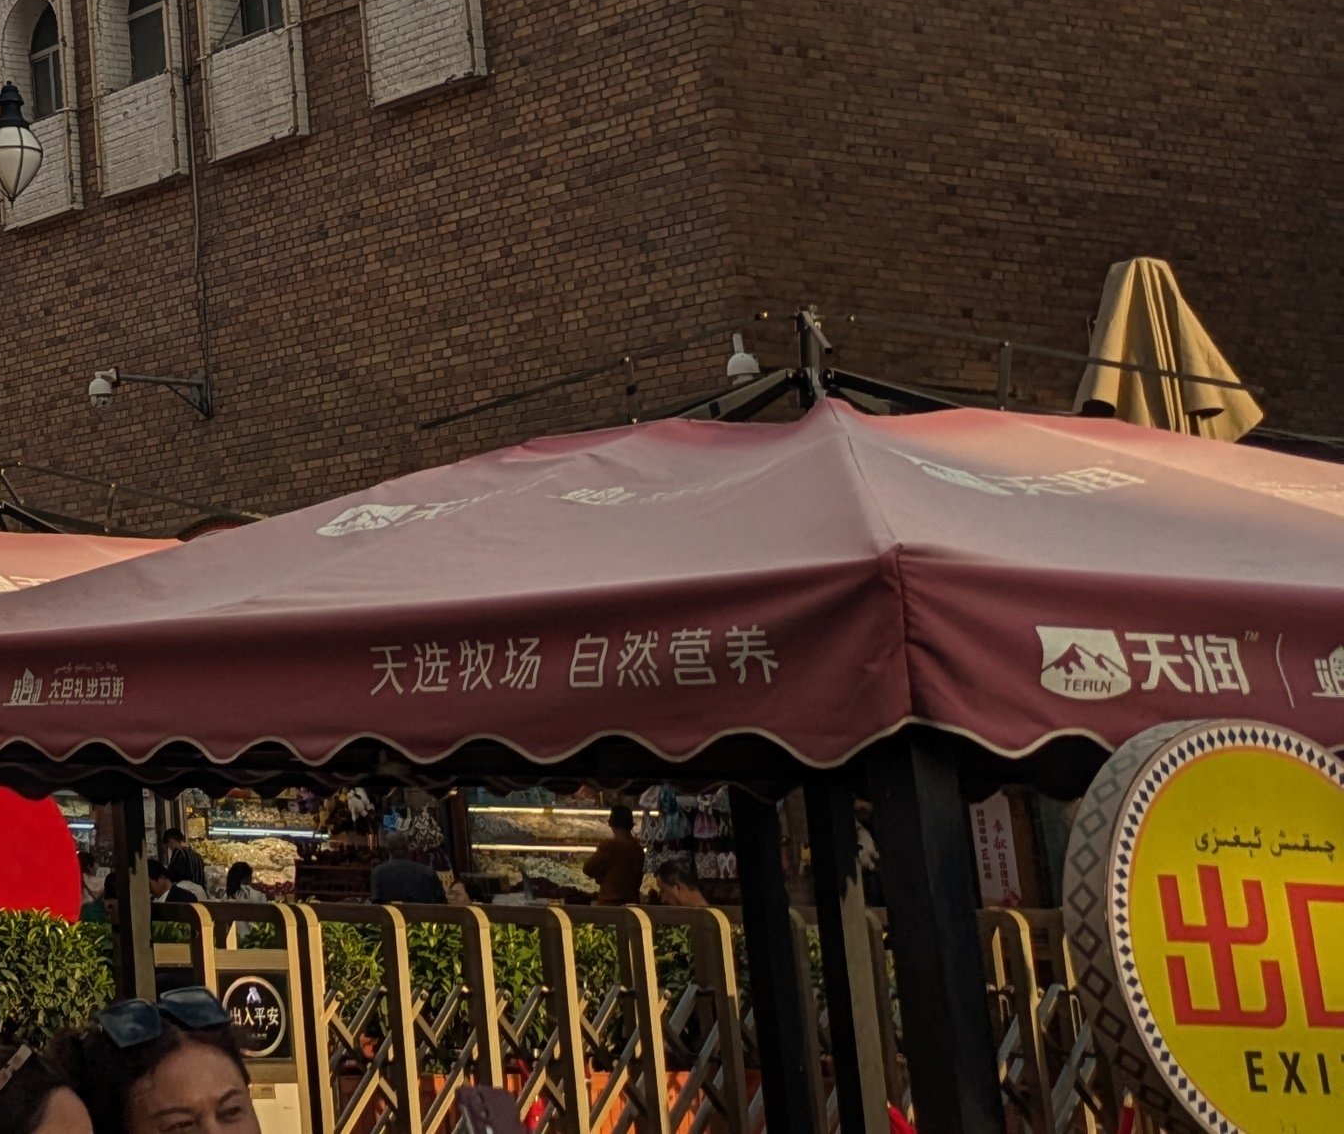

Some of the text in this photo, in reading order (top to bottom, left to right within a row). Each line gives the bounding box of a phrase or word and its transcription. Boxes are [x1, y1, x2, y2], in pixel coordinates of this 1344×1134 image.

[368, 624, 779, 697] 天选牧场 自然营养
[1124, 631, 1251, 696] 天润
[229, 1005, 280, 1027] 出入平安
[1243, 1050, 1344, 1096] EXI
